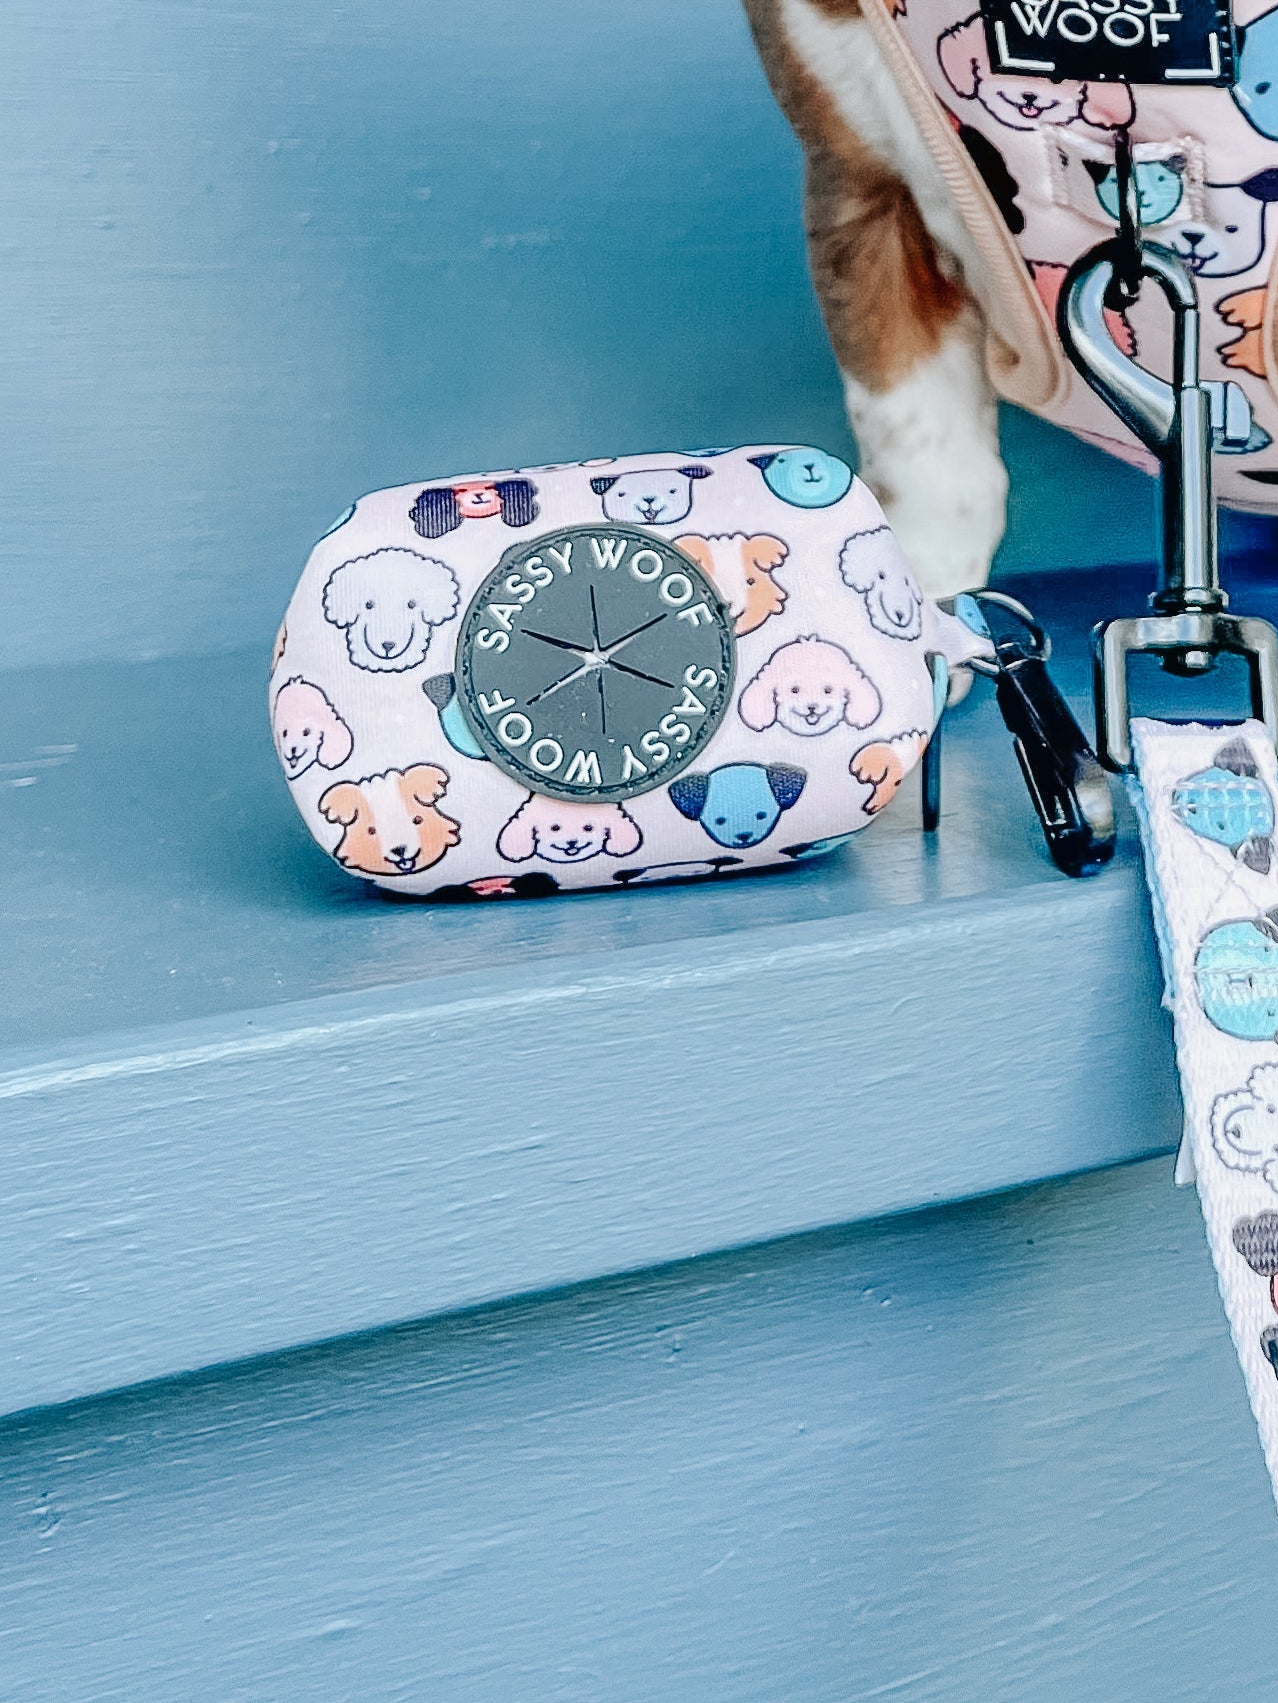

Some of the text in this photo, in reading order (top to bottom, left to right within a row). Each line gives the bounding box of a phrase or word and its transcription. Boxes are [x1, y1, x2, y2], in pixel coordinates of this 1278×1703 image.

[1010, 0, 1183, 48] WOOF
[475, 537, 714, 654] SASSY WOOF
[478, 664, 719, 785] SASSY WOOF
